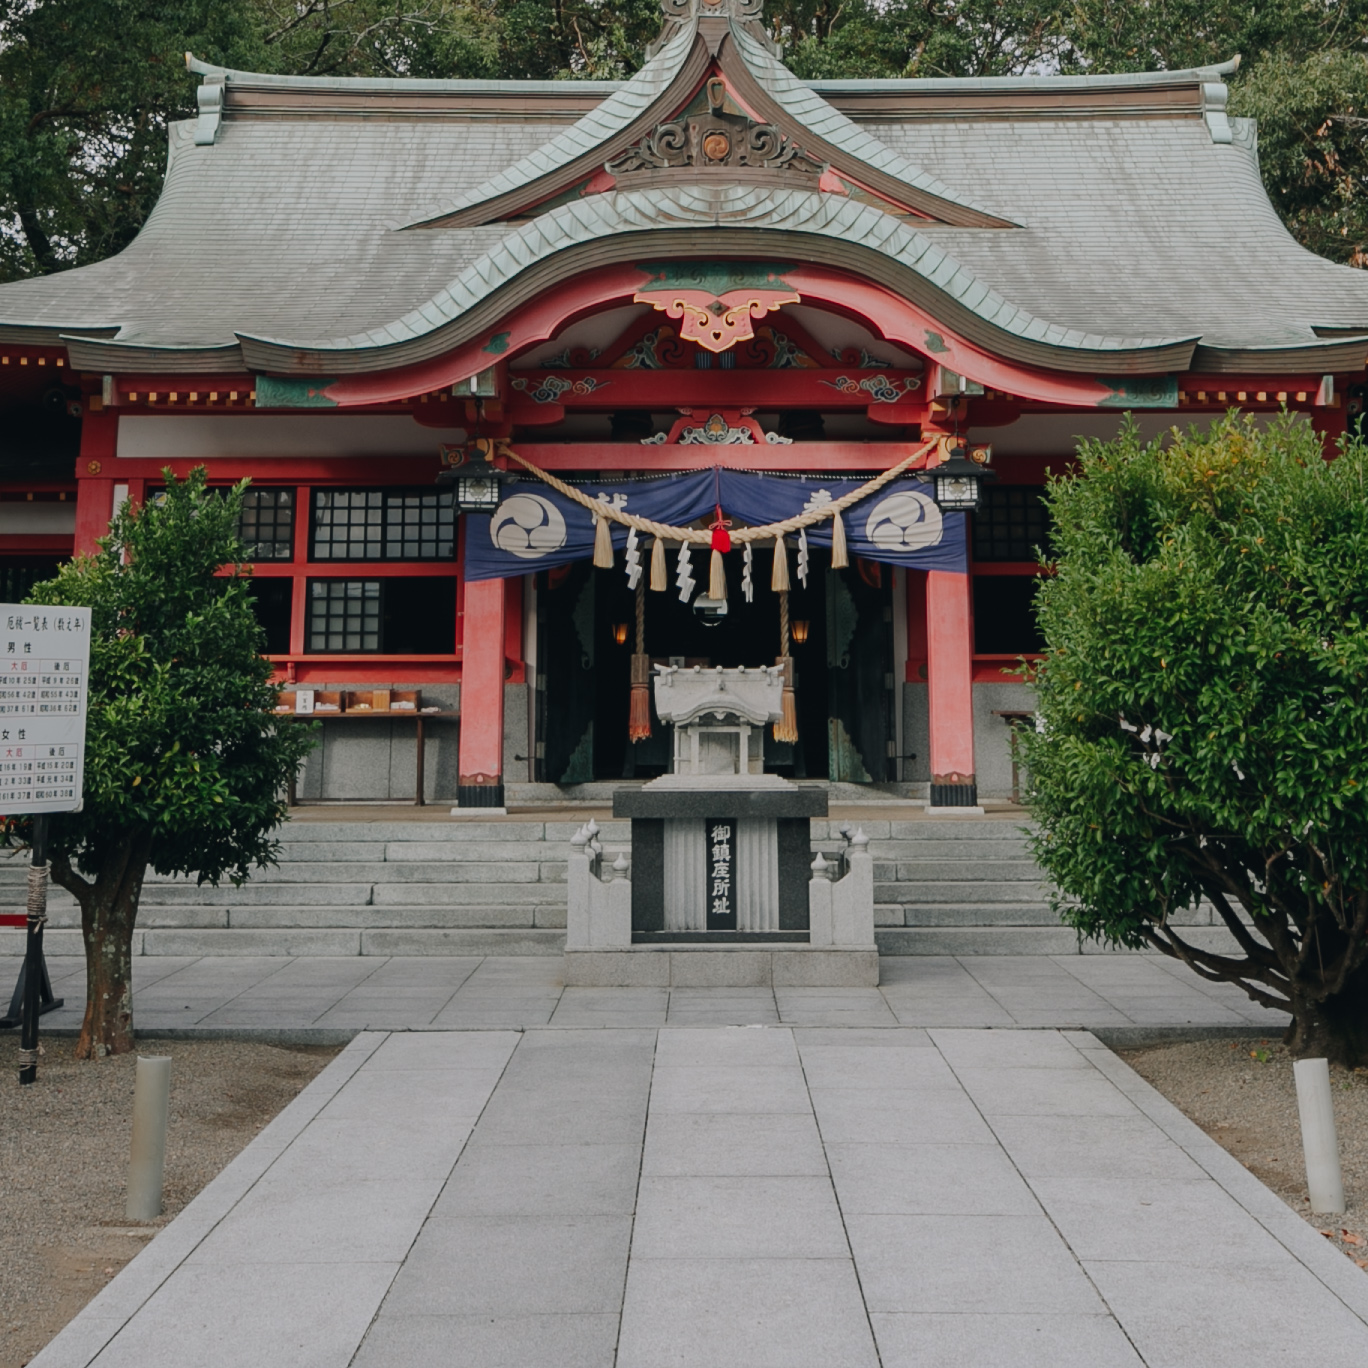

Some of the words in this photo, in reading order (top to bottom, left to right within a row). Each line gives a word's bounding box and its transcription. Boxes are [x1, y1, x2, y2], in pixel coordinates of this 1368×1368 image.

[711, 825, 731, 915] 御鎮座所址
